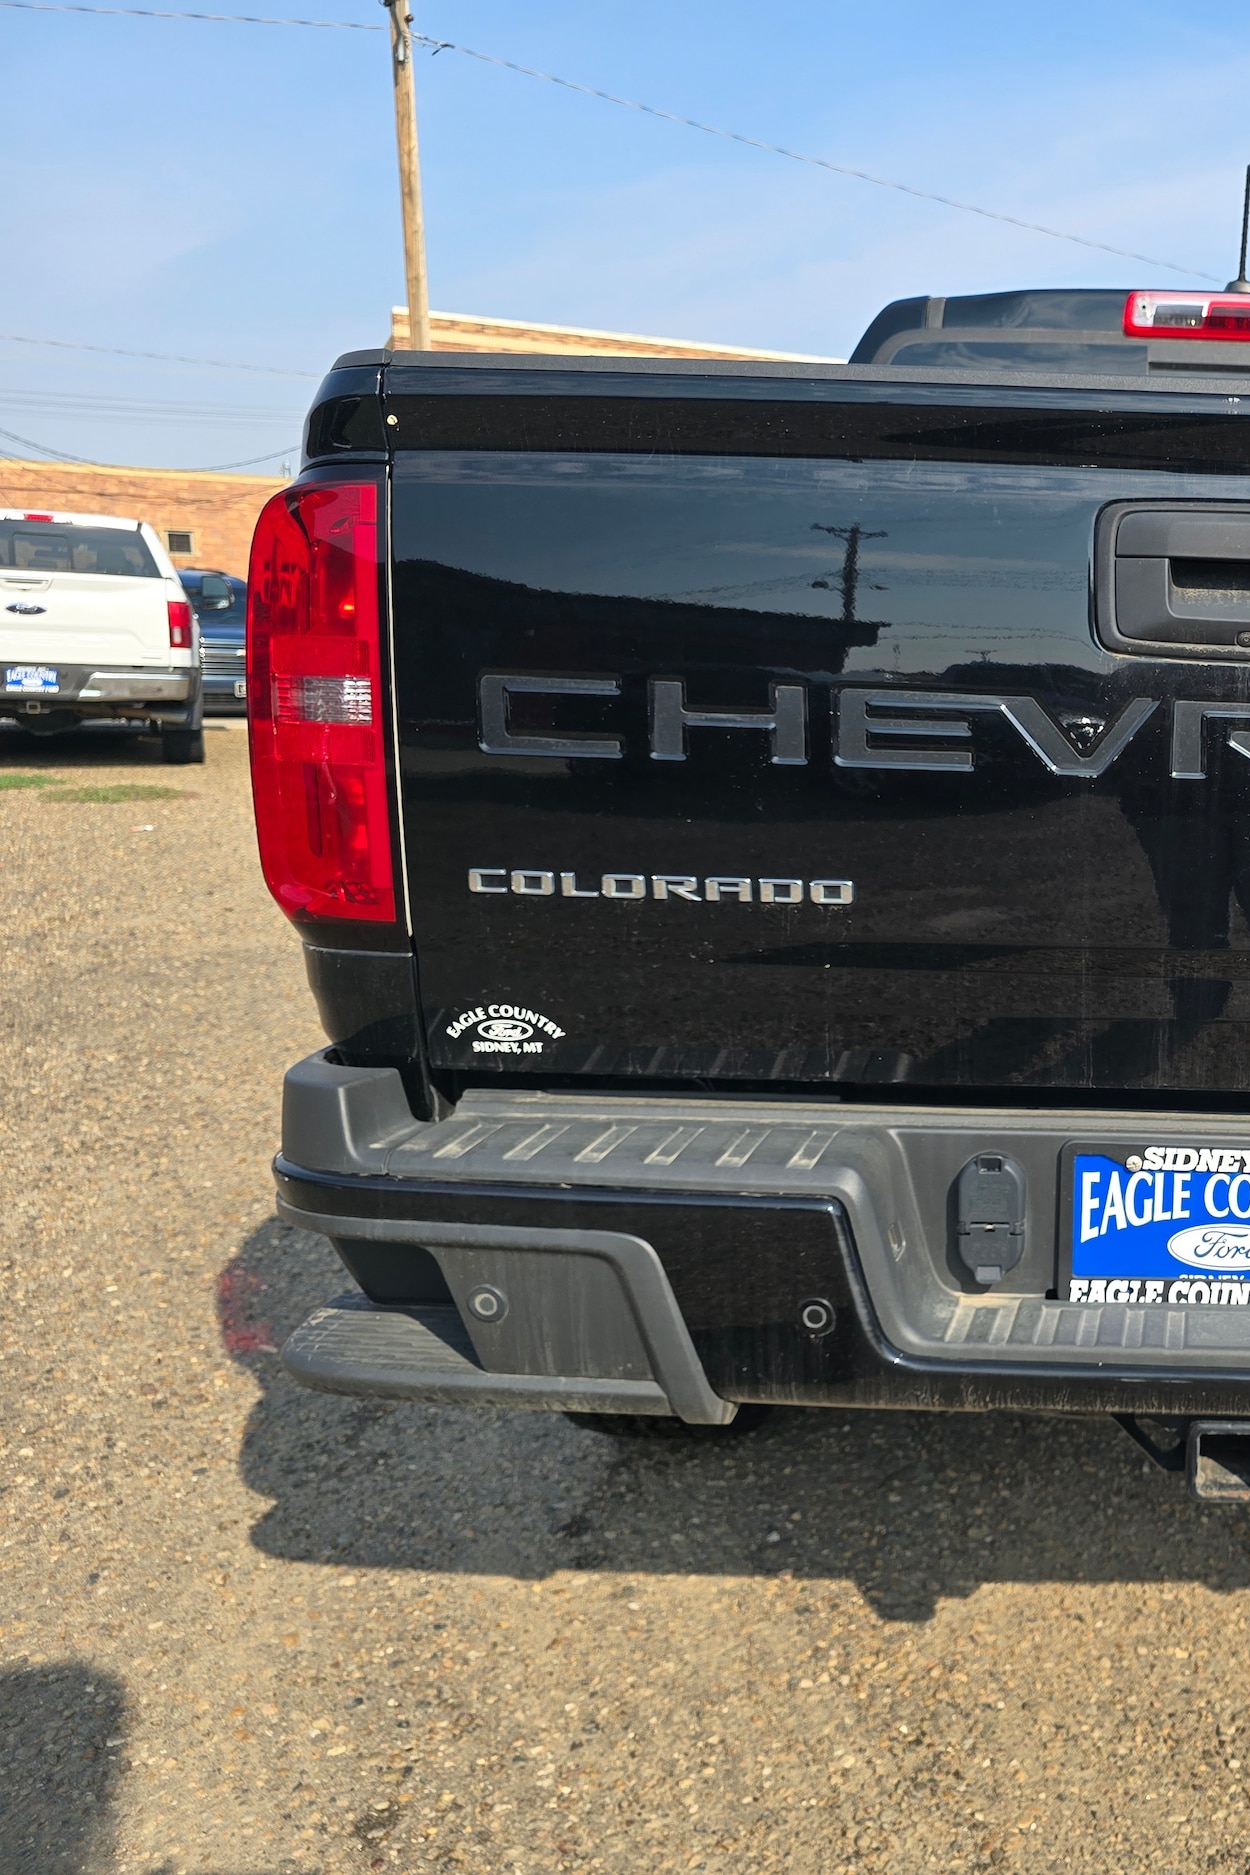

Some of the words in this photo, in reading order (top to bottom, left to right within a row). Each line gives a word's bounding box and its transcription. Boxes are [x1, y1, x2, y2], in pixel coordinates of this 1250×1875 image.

[468, 867, 855, 905] COLORADO
[446, 1006, 487, 1039] EAGLE
[488, 1004, 566, 1039] COUNTRY
[488, 1023, 523, 1037] Ford
[472, 1041, 521, 1055] SIDNEY,
[523, 1041, 544, 1053] MT
[1081, 1171, 1192, 1243] EAGLE
[1070, 1279, 1164, 1303] EAGLE
